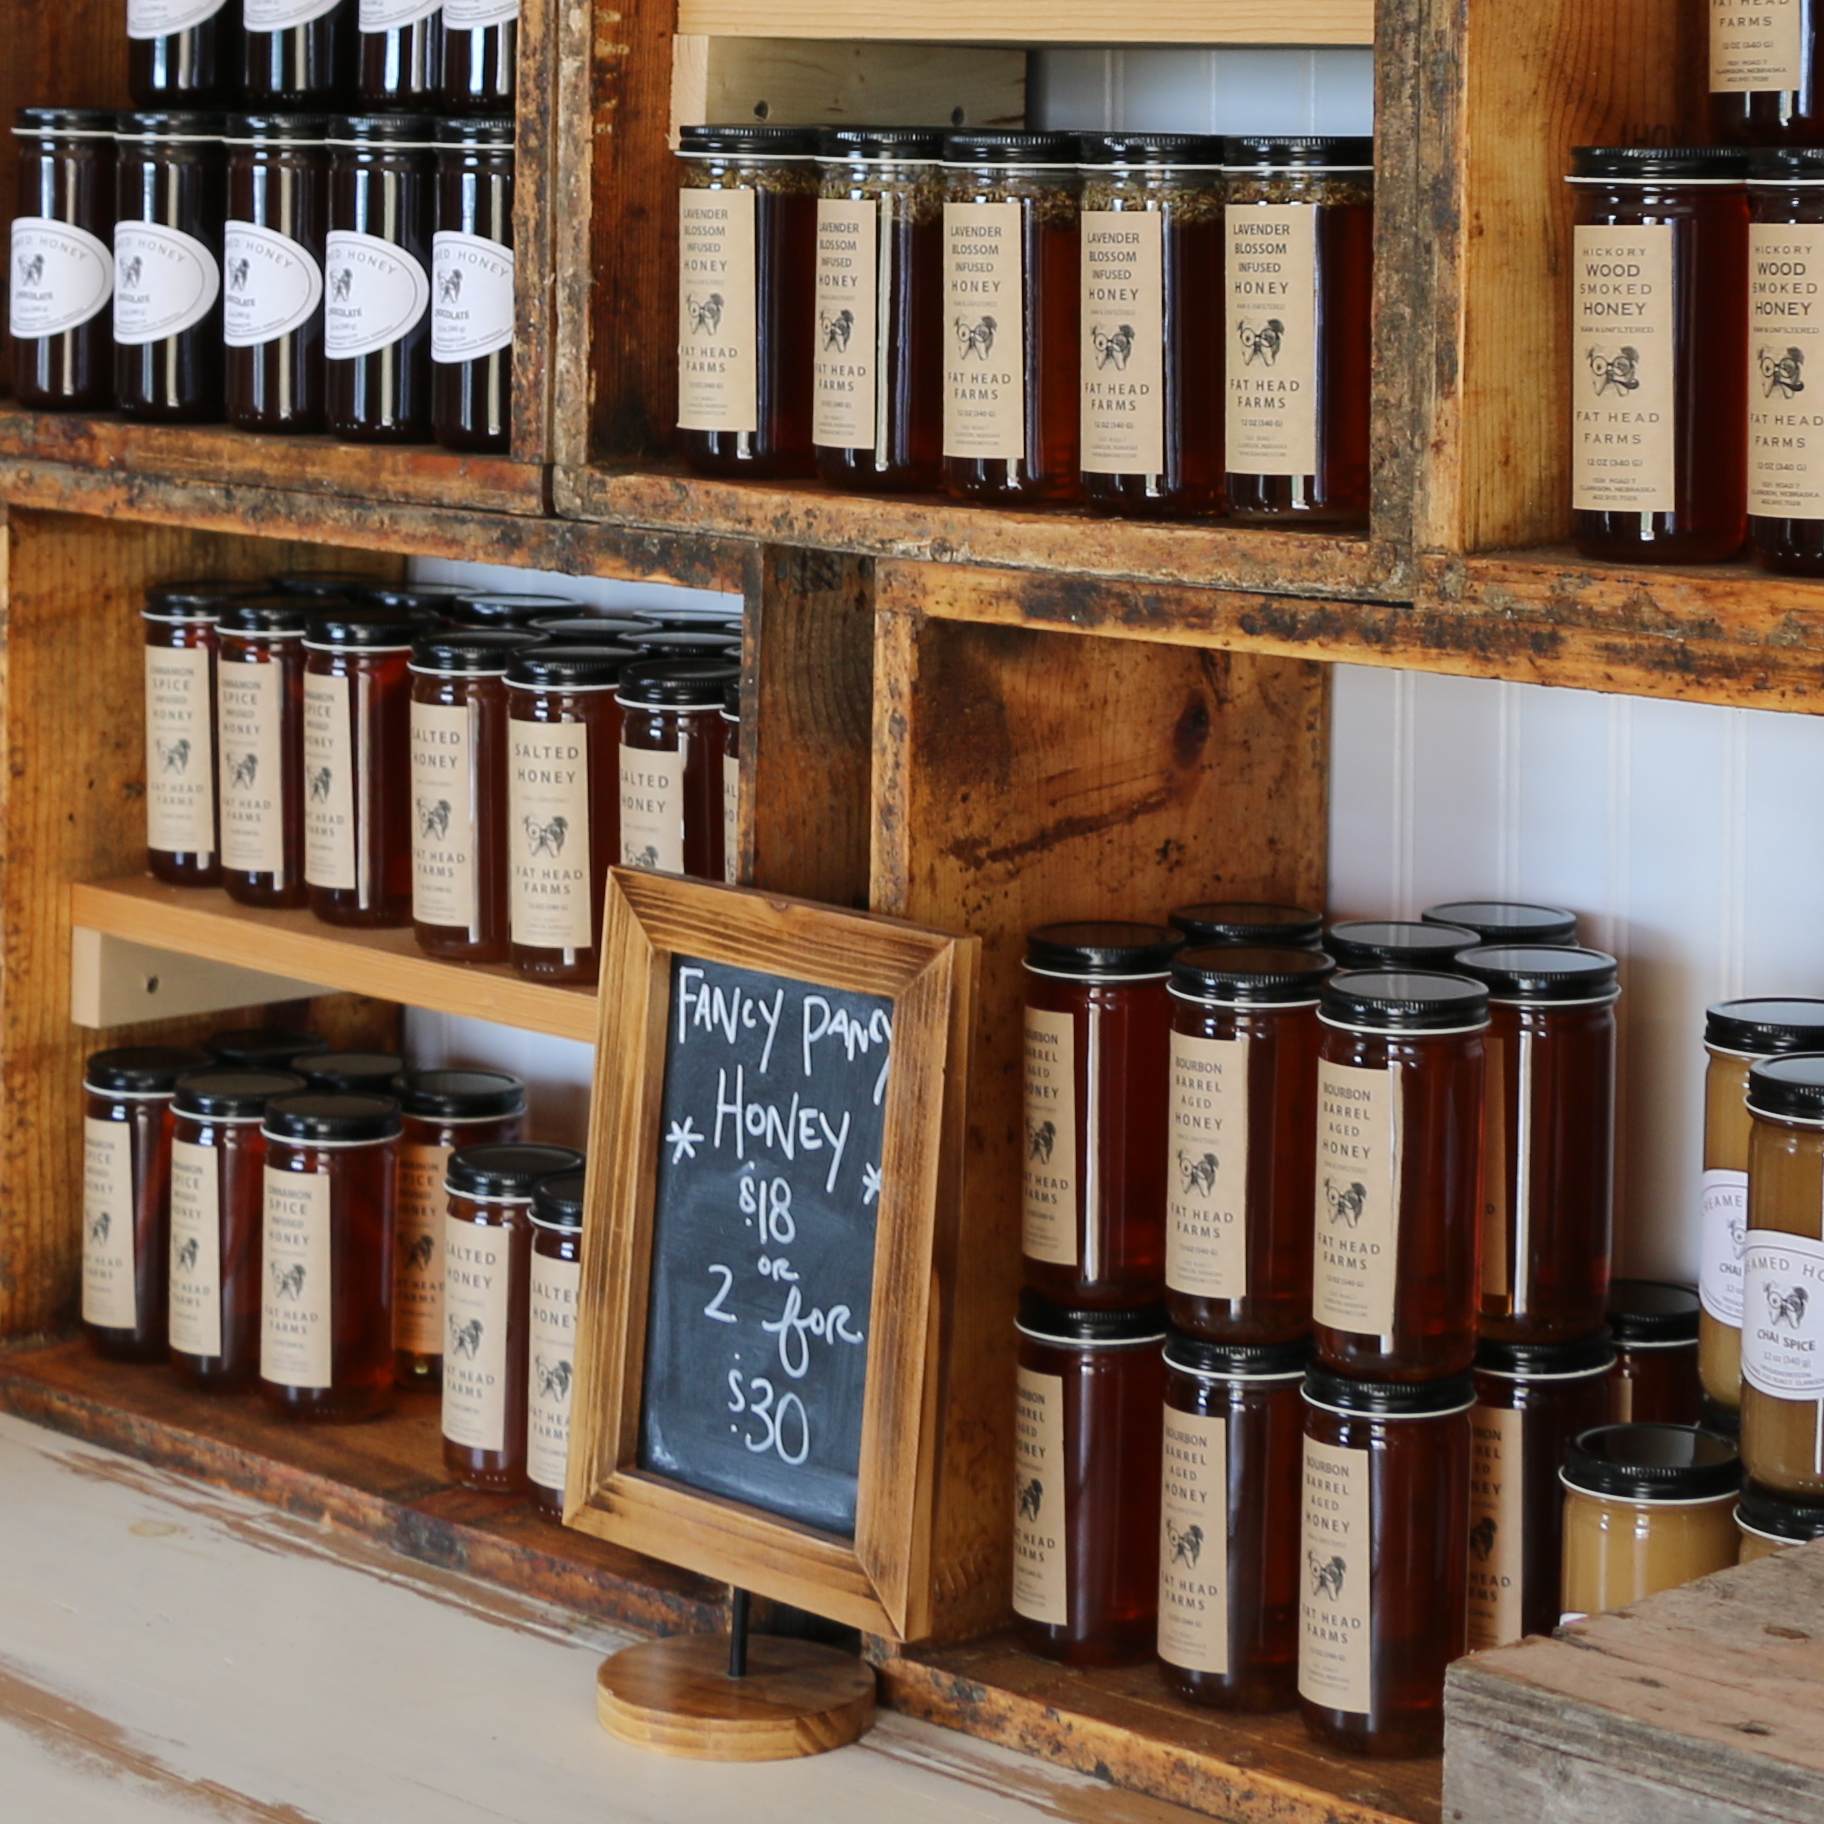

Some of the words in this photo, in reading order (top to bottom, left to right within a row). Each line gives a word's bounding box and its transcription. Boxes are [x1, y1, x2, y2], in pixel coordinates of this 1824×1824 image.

[1233, 223, 1290, 236] LAVENDER
[1234, 243, 1287, 255] BLOSSOM
[1583, 248, 1647, 257] HICKORY
[1238, 262, 1282, 273] INFUSED
[1586, 264, 1641, 278] WOOD
[1235, 281, 1289, 294] HONEY
[1580, 283, 1653, 295] SMOKED
[1583, 302, 1647, 316] HONEY
[1230, 378, 1249, 391] FAT
[1256, 380, 1300, 392] HEAD
[1237, 396, 1286, 409] FARMS
[1577, 411, 1600, 422] FAT
[1608, 412, 1661, 423] HEAD
[1584, 433, 1642, 444] FARMS
[515, 743, 579, 760] SALTED
[517, 769, 576, 784] HONEY
[679, 966, 784, 1074] FANCY
[1323, 1081, 1371, 1102] BOURBON
[1323, 1101, 1371, 1121] BARREL
[713, 1063, 851, 1193] HONEY
[1328, 1121, 1360, 1137] AGED
[1323, 1139, 1371, 1160] HONEY
[1339, 1240, 1381, 1255] HEAD
[1323, 1251, 1368, 1271] FARMS
[703, 1264, 738, 1323] 2
[1757, 1328, 1780, 1340] CHAI
[1783, 1336, 1816, 1352] SPICE
